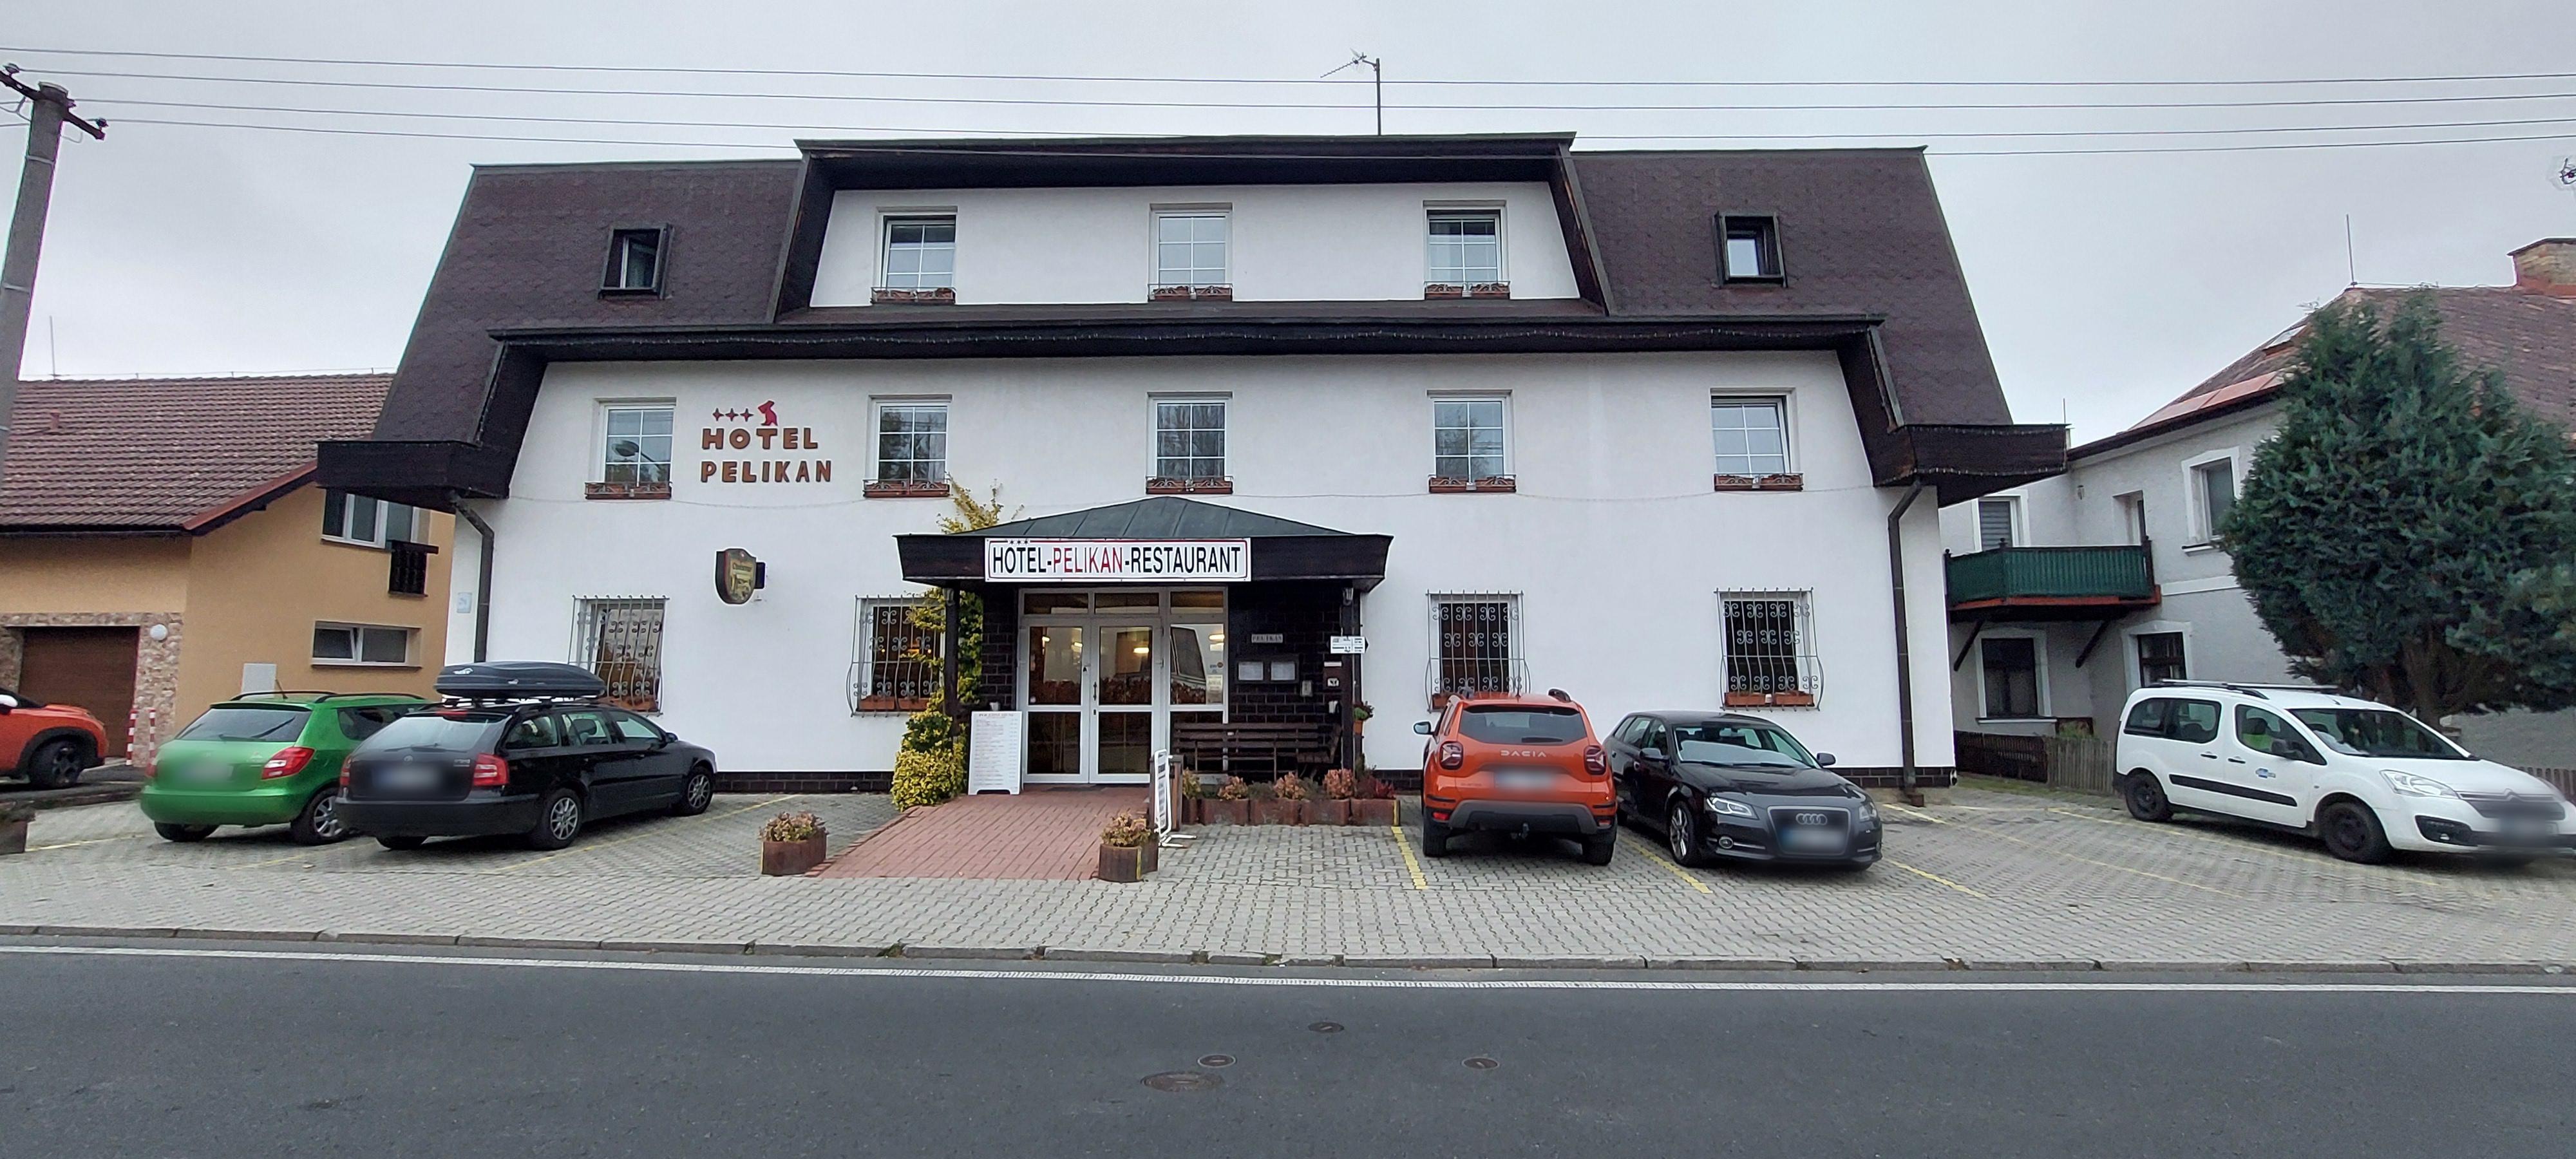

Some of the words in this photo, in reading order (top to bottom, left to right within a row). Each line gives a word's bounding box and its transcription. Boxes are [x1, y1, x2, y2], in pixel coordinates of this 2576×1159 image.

[701, 428, 818, 449] HOTEL
[701, 460, 831, 483] PELIKAN
[993, 547, 1241, 573] HOTEL-PELIKAN-RESTAURANT
[1501, 749, 1546, 758] DACIA
